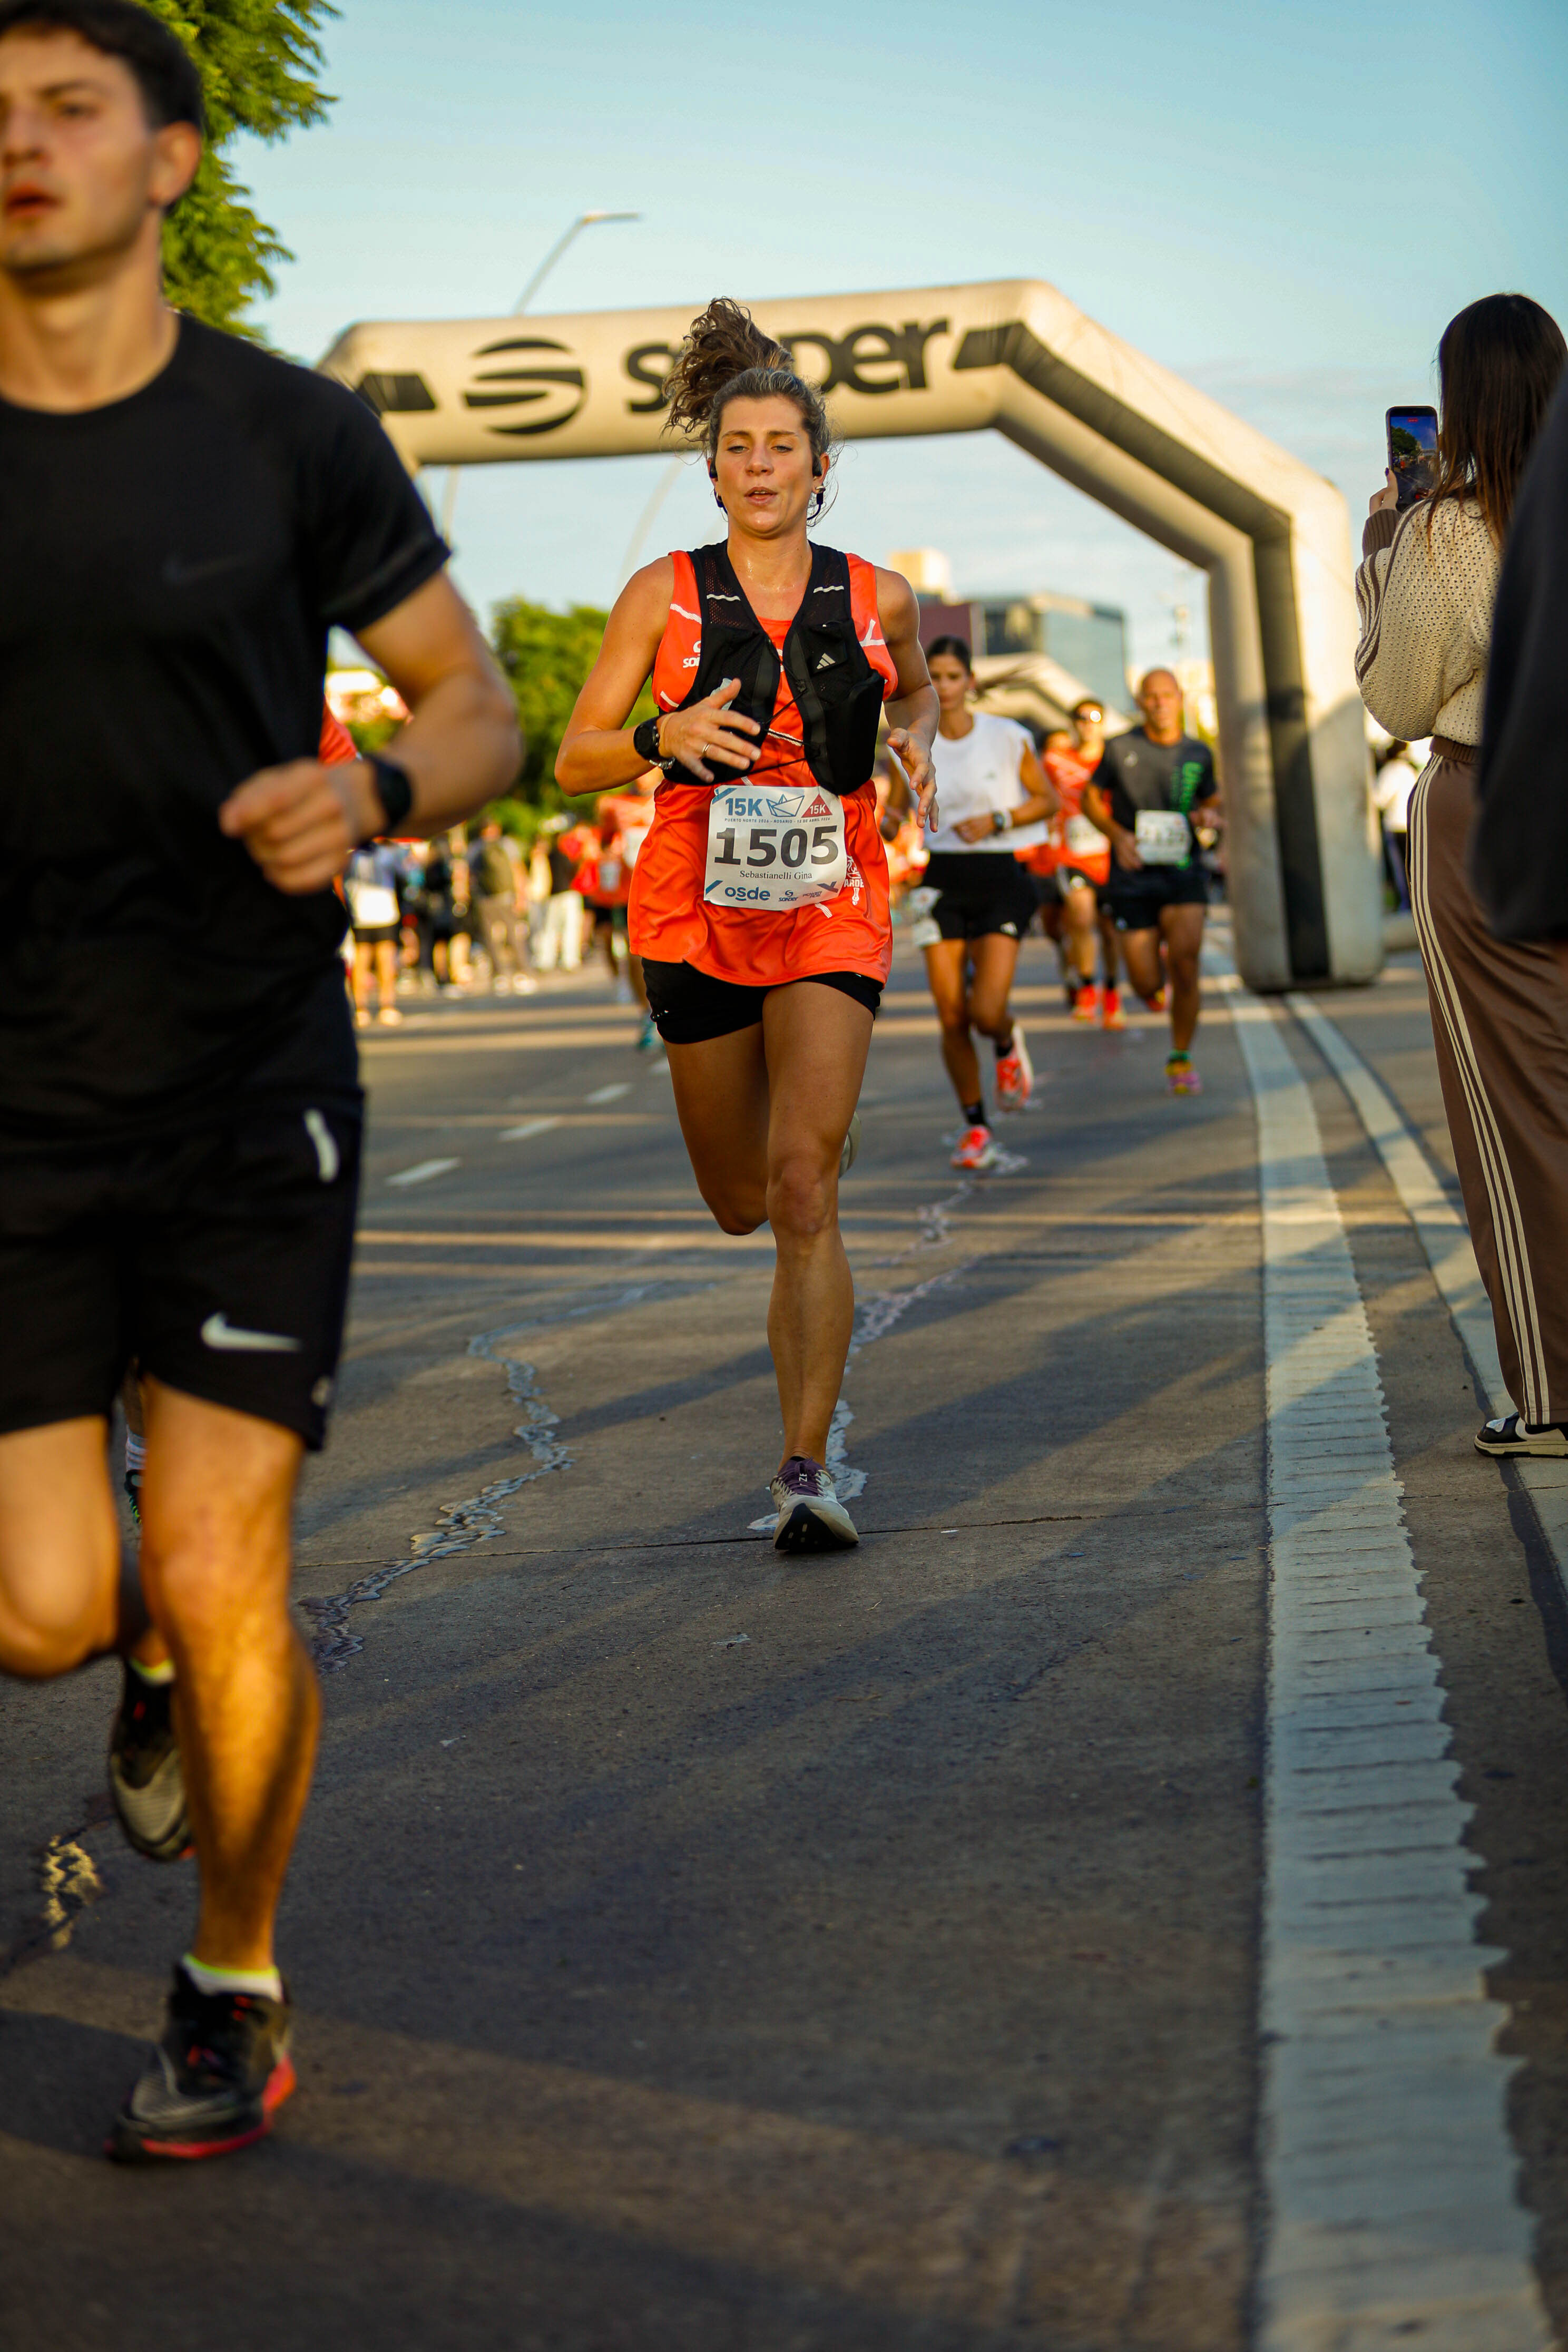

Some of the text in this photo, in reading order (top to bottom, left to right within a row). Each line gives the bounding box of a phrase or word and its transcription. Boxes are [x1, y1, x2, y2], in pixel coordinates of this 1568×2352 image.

[725, 798, 763, 816] 15K
[809, 804, 826, 814] 15K
[714, 825, 839, 868] 1505
[739, 870, 812, 880] Sebastianelli Gina
[724, 886, 771, 901] osde
